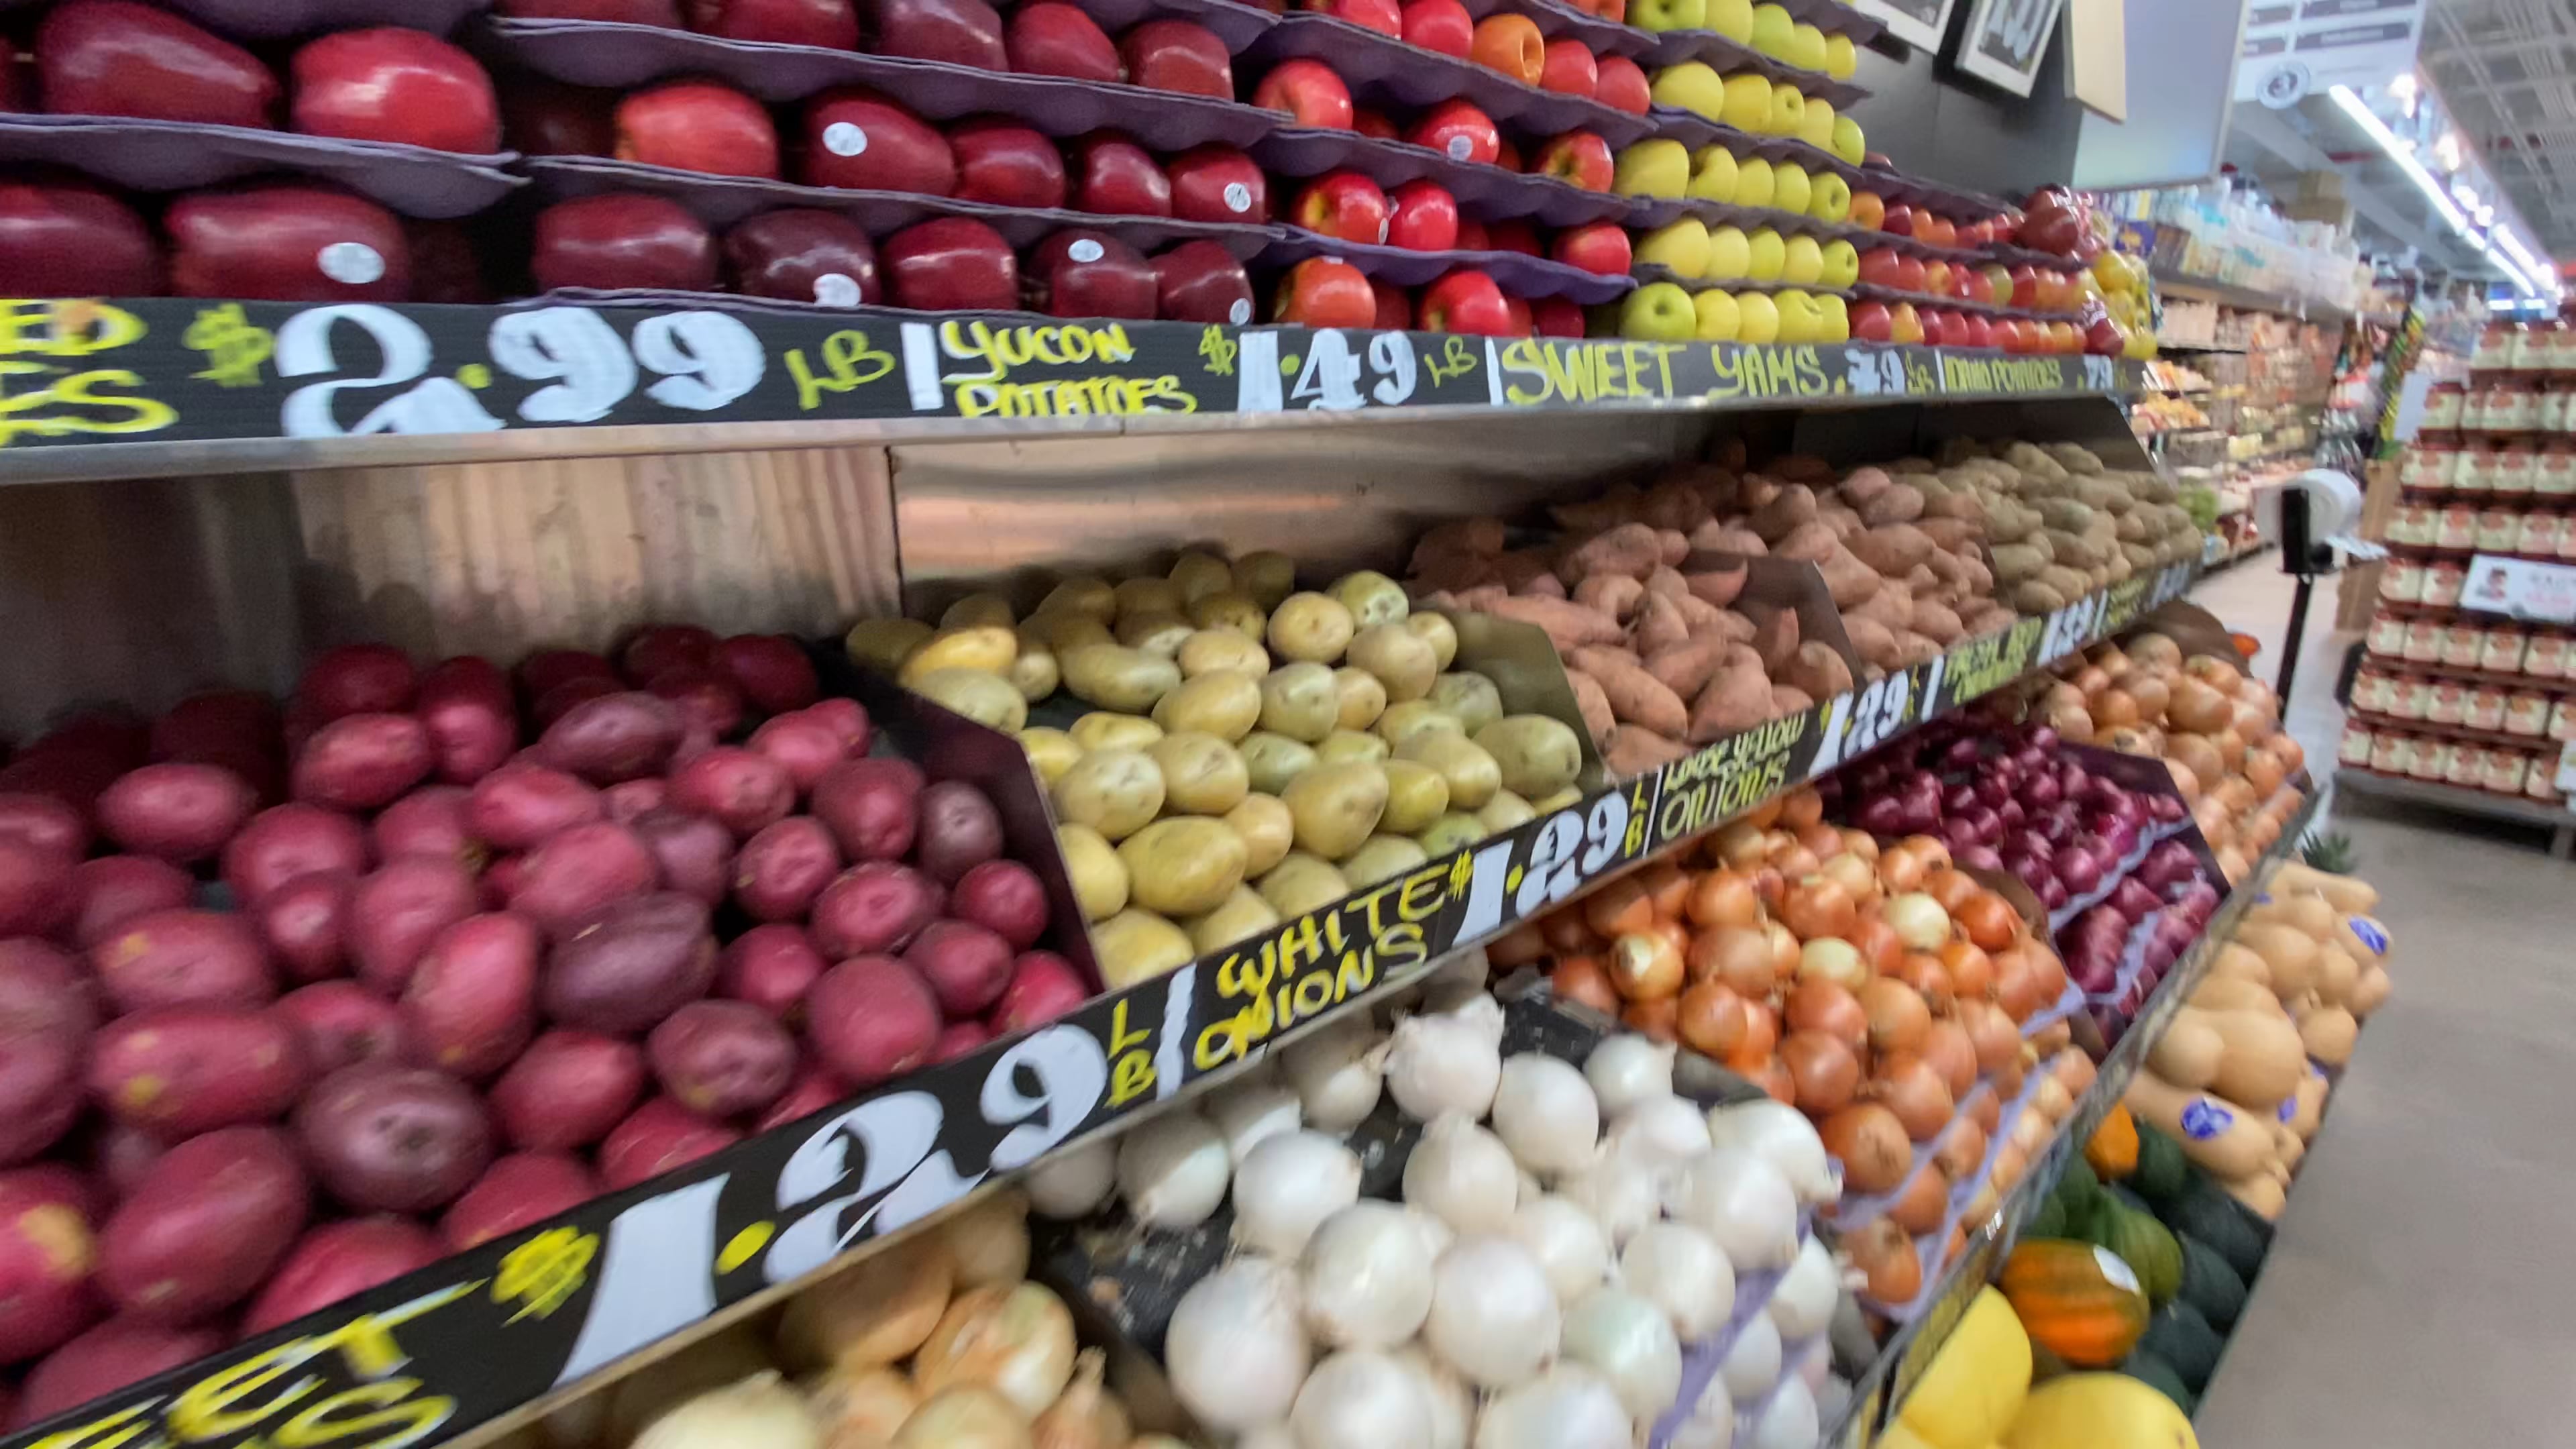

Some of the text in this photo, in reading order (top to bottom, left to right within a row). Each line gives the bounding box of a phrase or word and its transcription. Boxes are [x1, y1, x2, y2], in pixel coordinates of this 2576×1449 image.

[784, 329, 895, 411] LB
[941, 321, 1137, 384] YUCON
[1424, 335, 1477, 388] LB
[1502, 338, 1686, 403] SWEET
[955, 374, 1198, 419] POTATOES
[1625, 782, 1648, 858] LB
[1216, 863, 1450, 1000] WHITE
[1193, 924, 1428, 1071] ONIONS
[1105, 1000, 1156, 1109] LB
